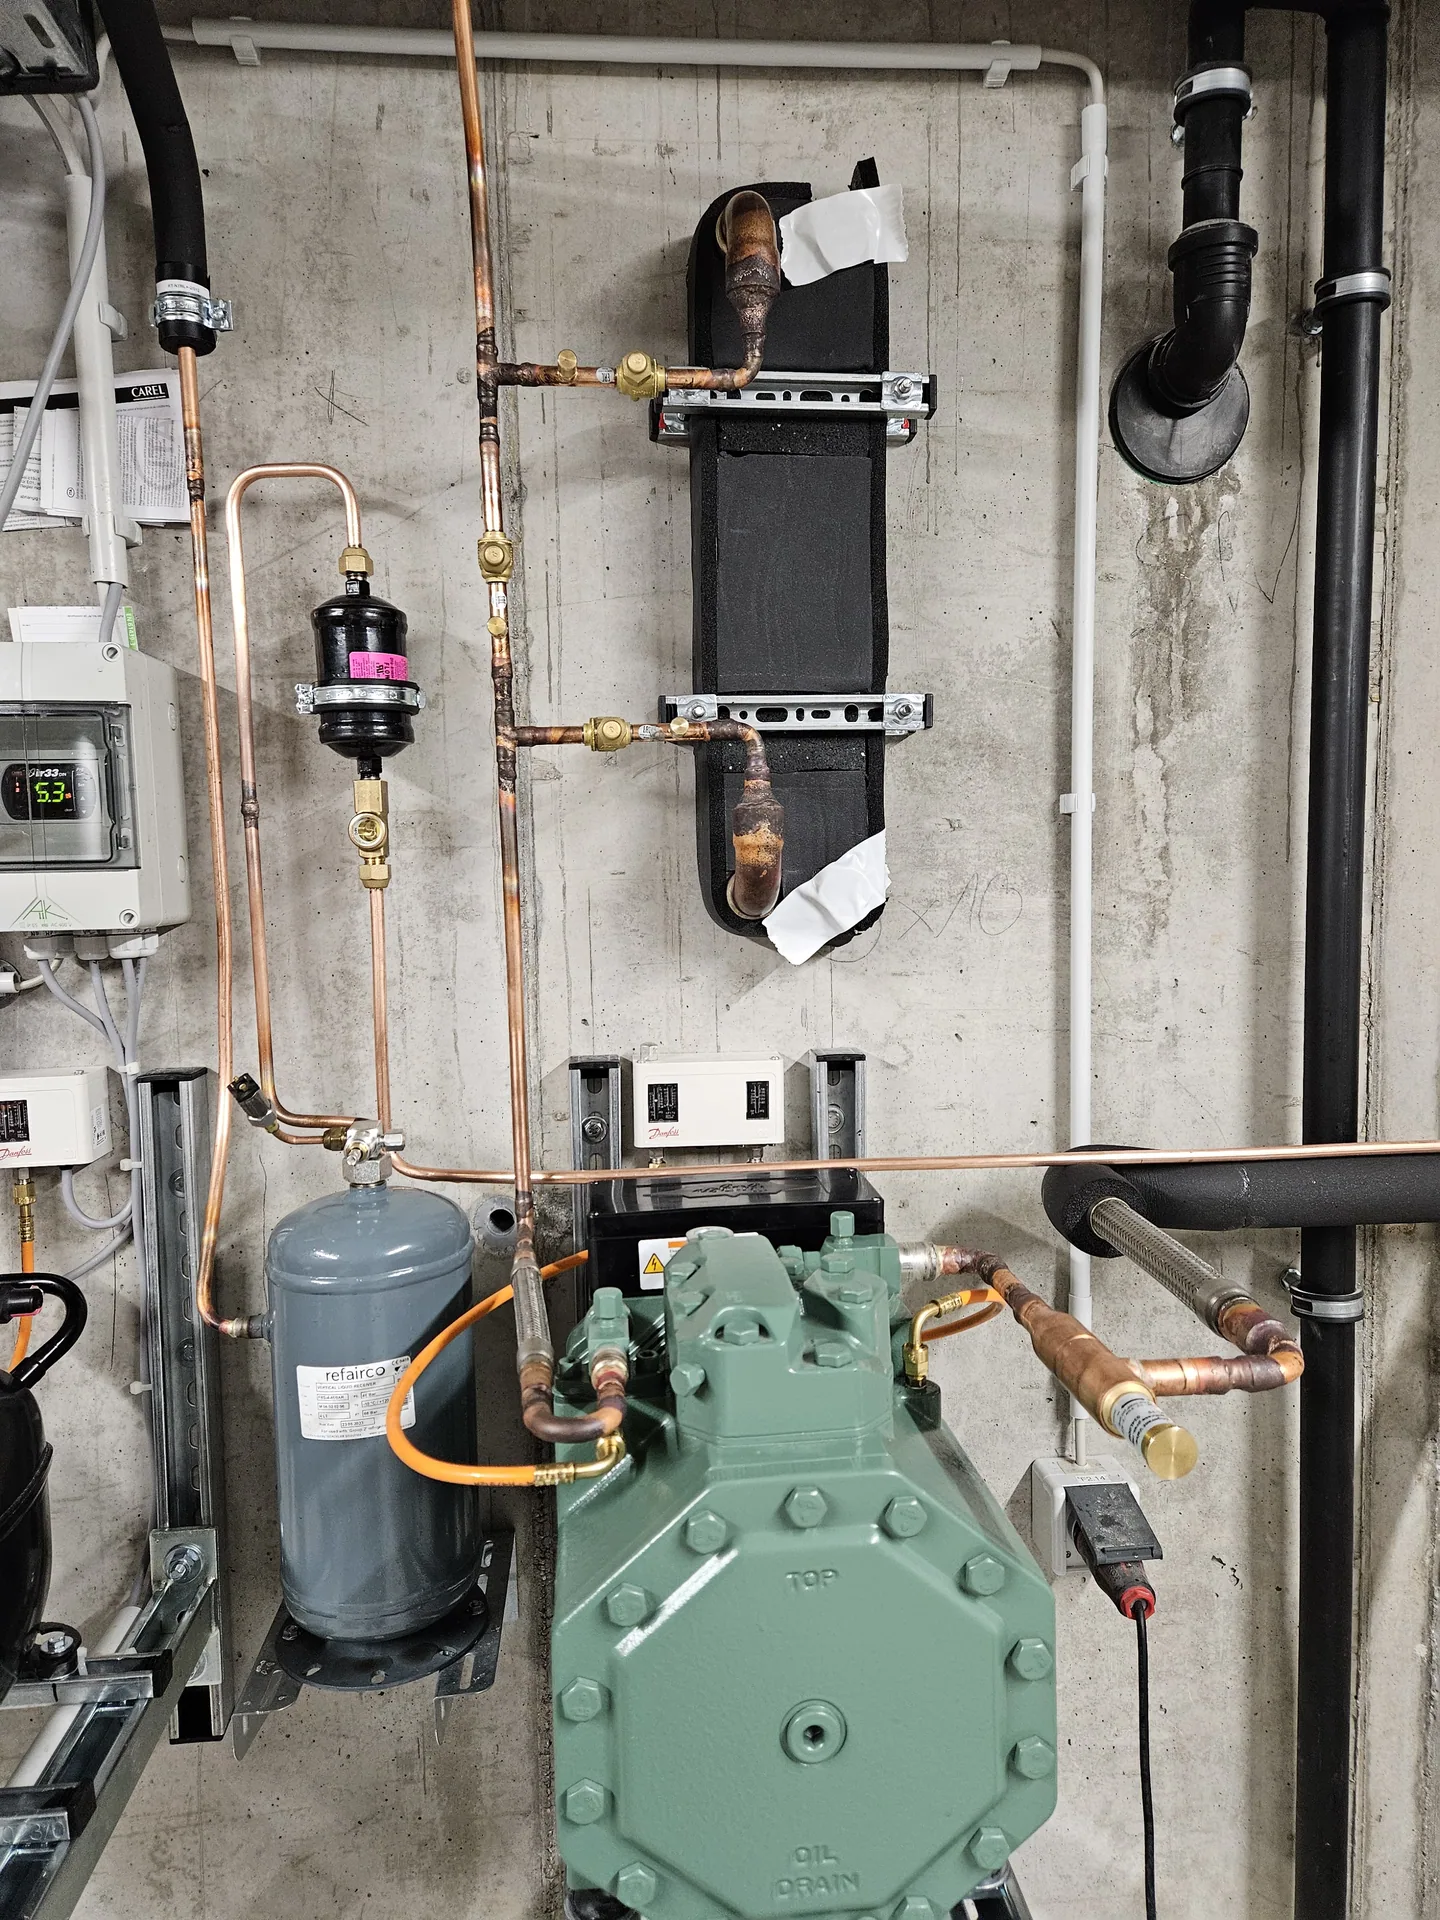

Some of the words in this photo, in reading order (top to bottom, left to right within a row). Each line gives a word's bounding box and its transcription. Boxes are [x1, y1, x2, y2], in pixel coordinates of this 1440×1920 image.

[131, 384, 166, 397] CAREL
[648, 1126, 680, 1139] Danfoss
[325, 1366, 386, 1382] refairco
[784, 1568, 840, 1591] TOP
[793, 1845, 840, 1867] OIL
[772, 1873, 861, 1900] DRAIN
